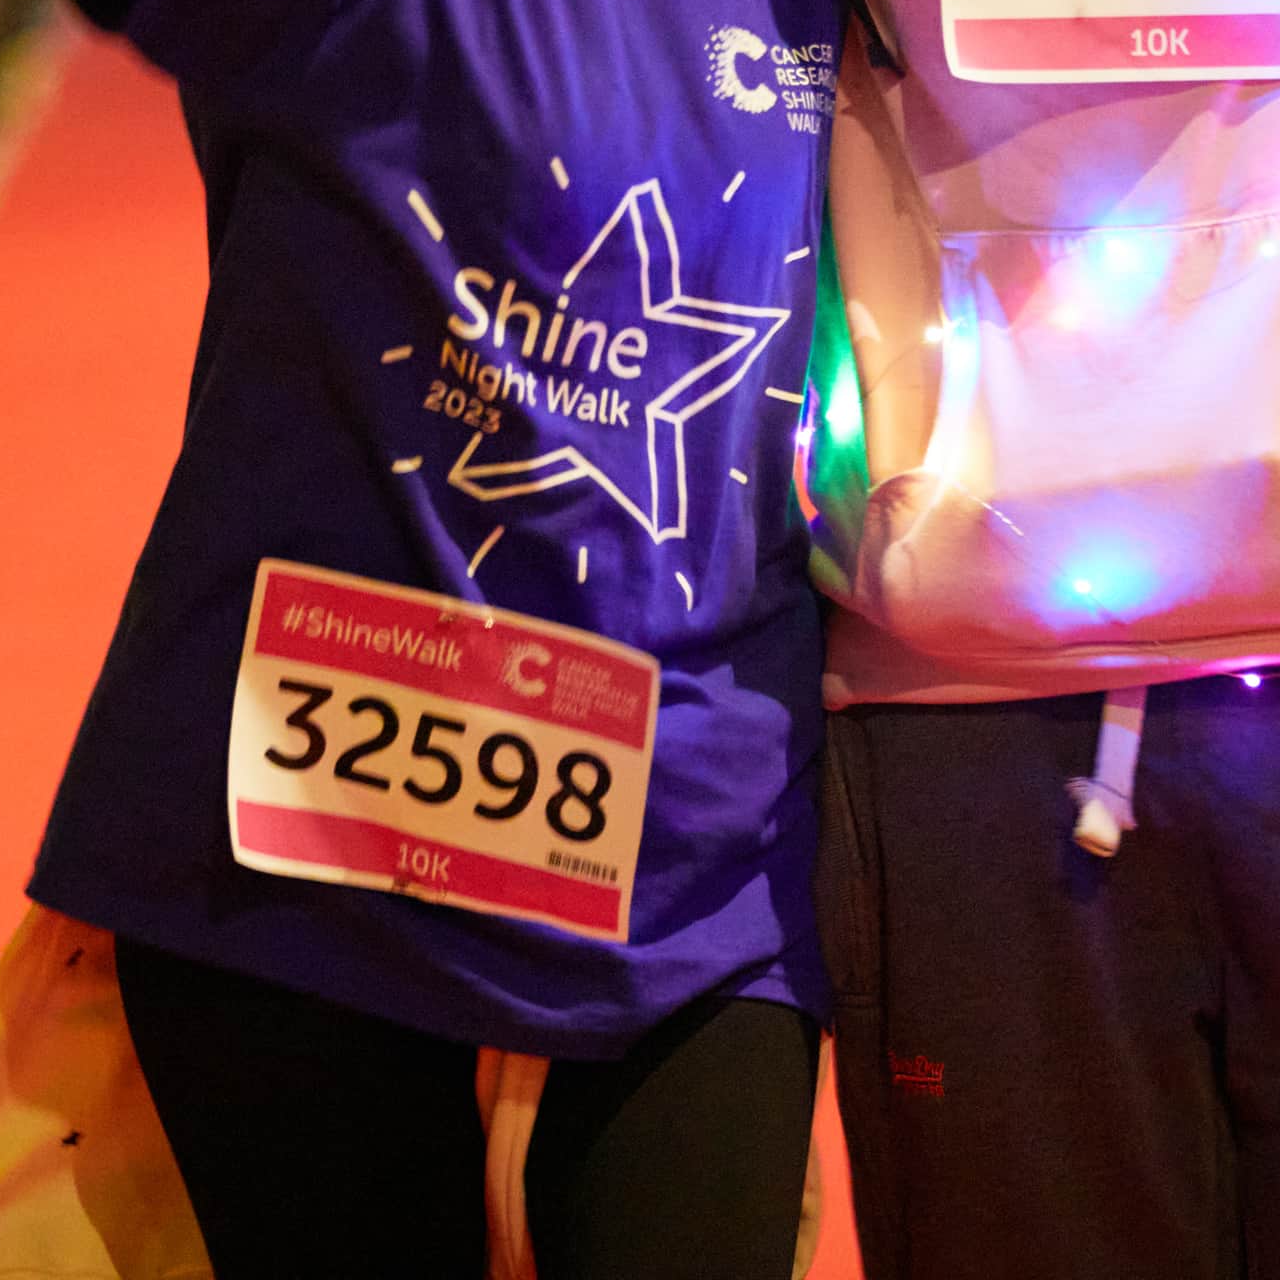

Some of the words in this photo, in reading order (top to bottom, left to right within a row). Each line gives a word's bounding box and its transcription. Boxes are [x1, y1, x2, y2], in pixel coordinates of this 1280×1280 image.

[1129, 27, 1191, 58] 10K
[447, 266, 649, 380] Shine
[423, 379, 502, 435] 2023
[439, 338, 537, 408] Night
[546, 374, 631, 429] Walk
[282, 601, 464, 672] #ShineWalk
[263, 676, 612, 842] 32598
[396, 842, 450, 882] 10K
